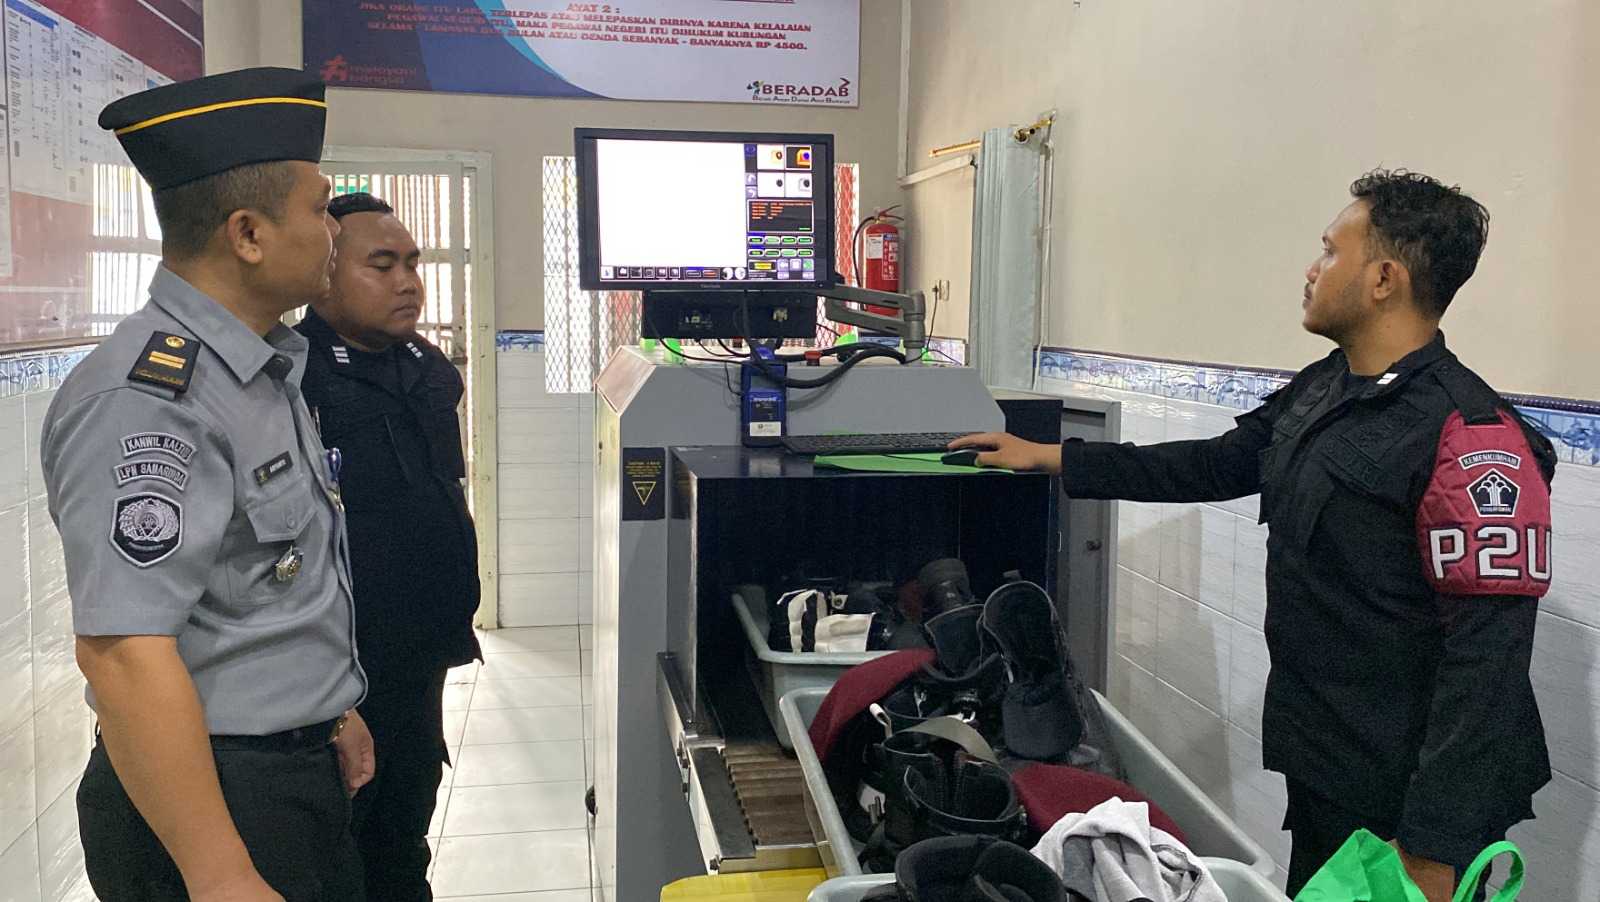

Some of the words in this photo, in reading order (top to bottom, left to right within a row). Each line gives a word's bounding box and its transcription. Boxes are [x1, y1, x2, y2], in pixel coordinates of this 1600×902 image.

[566, 4, 598, 12] AYAT
[602, 5, 611, 13] 2
[490, 9, 548, 19] TERLEPAS
[583, 14, 656, 25] MELEPASKAN
[659, 18, 704, 27] DIRINYA
[708, 20, 750, 30] KARENA
[753, 22, 811, 32] KELALAIAN
[516, 20, 548, 29] MAKA
[551, 22, 602, 31] PEGAWAI
[605, 25, 646, 34] NEGERI
[650, 26, 668, 35] ITU
[672, 28, 724, 37] DIHUKUM
[508, 29, 545, 38] BULAN
[549, 31, 578, 39] ATAU
[581, 33, 618, 42] DENDA
[622, 35, 679, 45] SEBANYAK
[690, 38, 752, 48] BANYAKNYA
[756, 41, 771, 49] RP
[774, 42, 808, 50] 4500.
[762, 84, 849, 97] BERADAB
[126, 437, 161, 451] KANWIL
[1429, 525, 1551, 580] P2U
